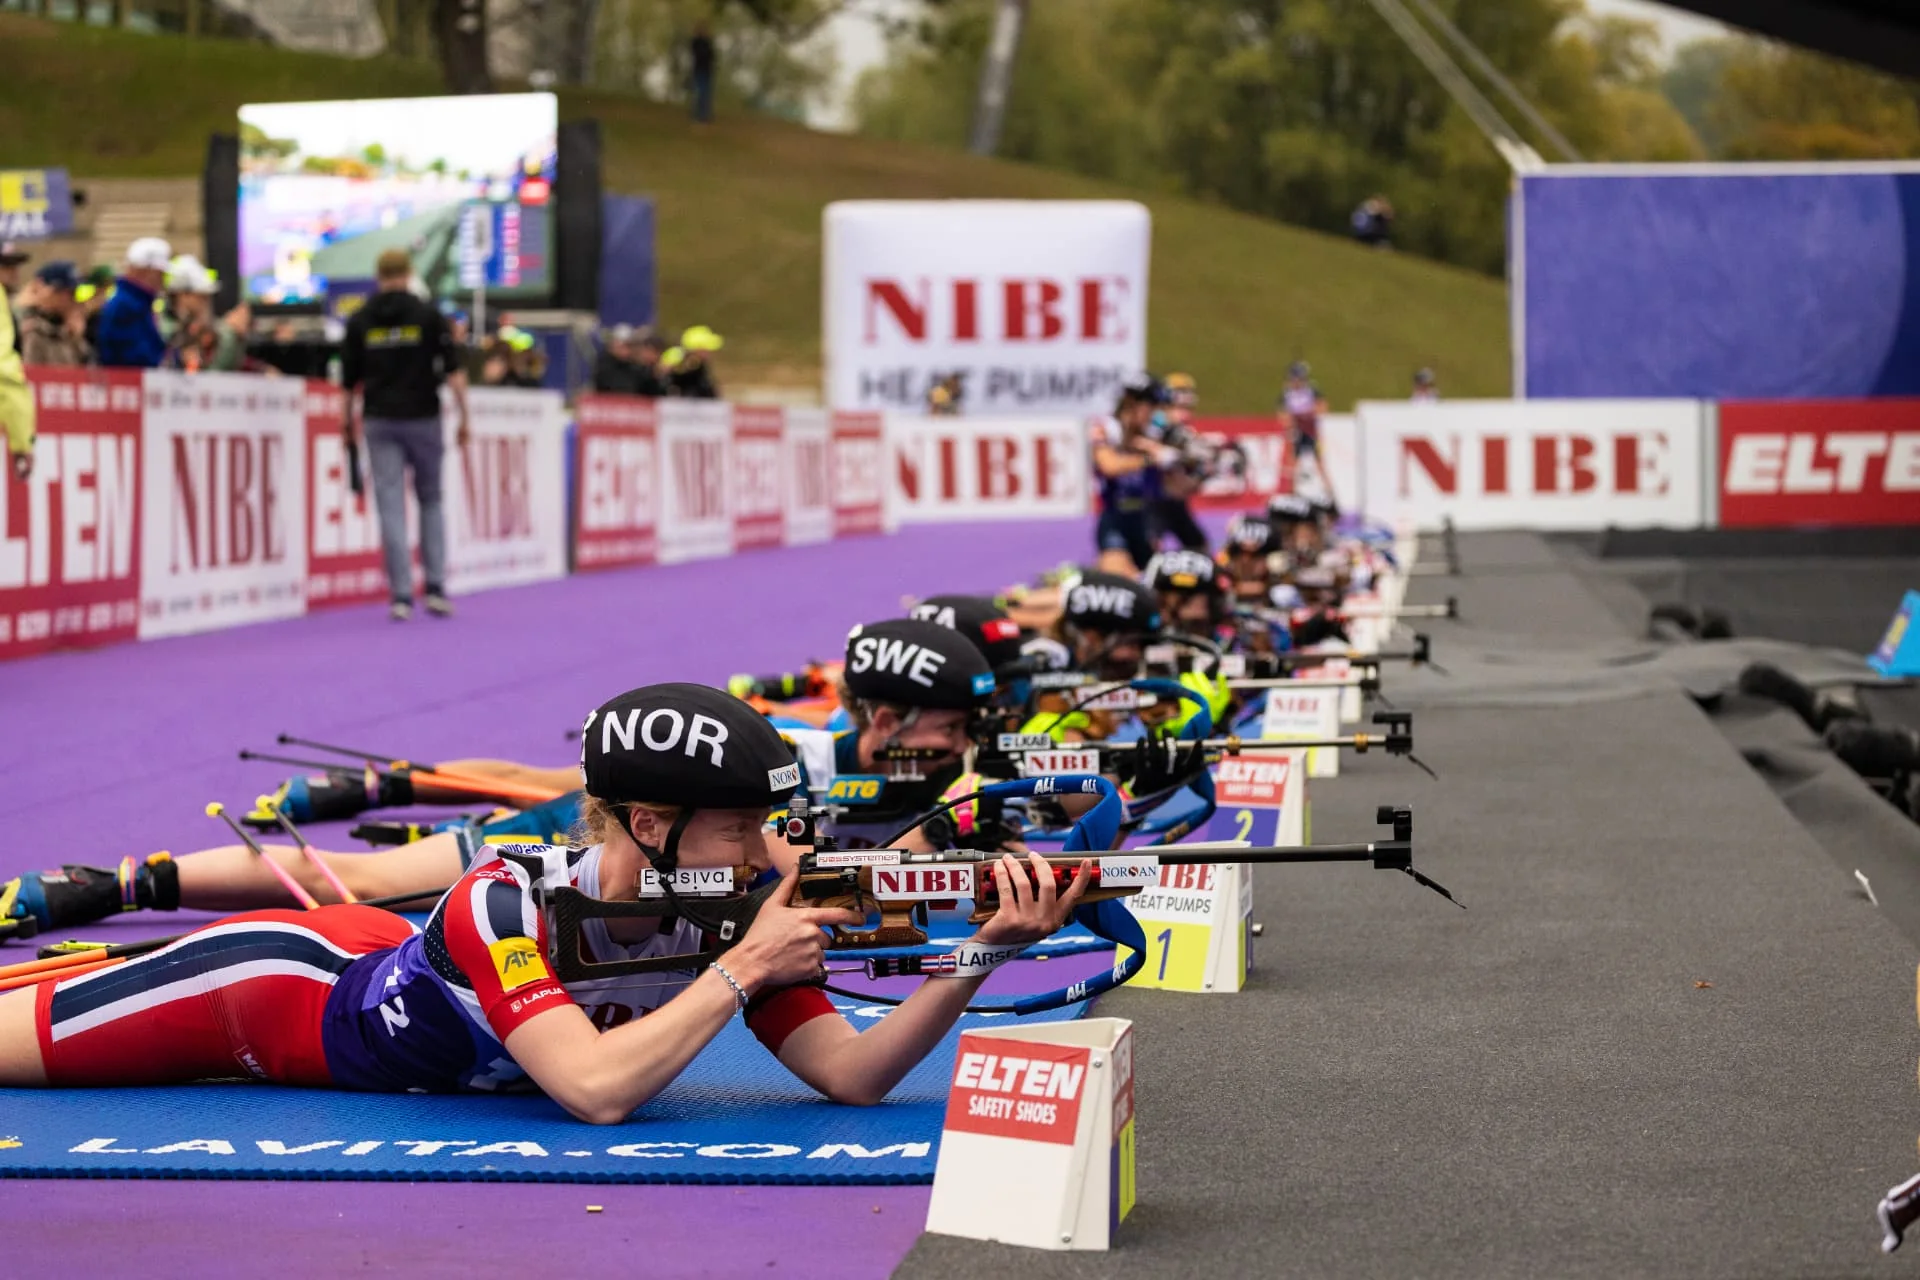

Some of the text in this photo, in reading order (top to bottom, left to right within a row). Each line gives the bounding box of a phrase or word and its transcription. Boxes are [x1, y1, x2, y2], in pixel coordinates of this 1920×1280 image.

[862, 275, 1131, 344] NIBE
[895, 435, 1077, 504] NIBE
[1396, 431, 1671, 498] NIBE
[168, 432, 285, 576] NIBE
[1069, 584, 1137, 618] SWE
[851, 637, 947, 688] SWE
[602, 708, 729, 768] NOR
[1030, 754, 1096, 771] NIBE
[828, 780, 880, 798] ATG
[1235, 808, 1254, 843] 2
[876, 869, 971, 894] NIBE
[1102, 865, 1157, 878] NORSAN
[1158, 864, 1217, 892] IBE
[1131, 895, 1213, 914] HEAT PUMPS
[1157, 928, 1172, 981] 1
[523, 987, 565, 1005] LAPUA
[954, 1052, 1086, 1100] ELTEN
[968, 1094, 1058, 1125] SAFETY SHOES
[68, 1138, 931, 1159] LAVITA.COM
